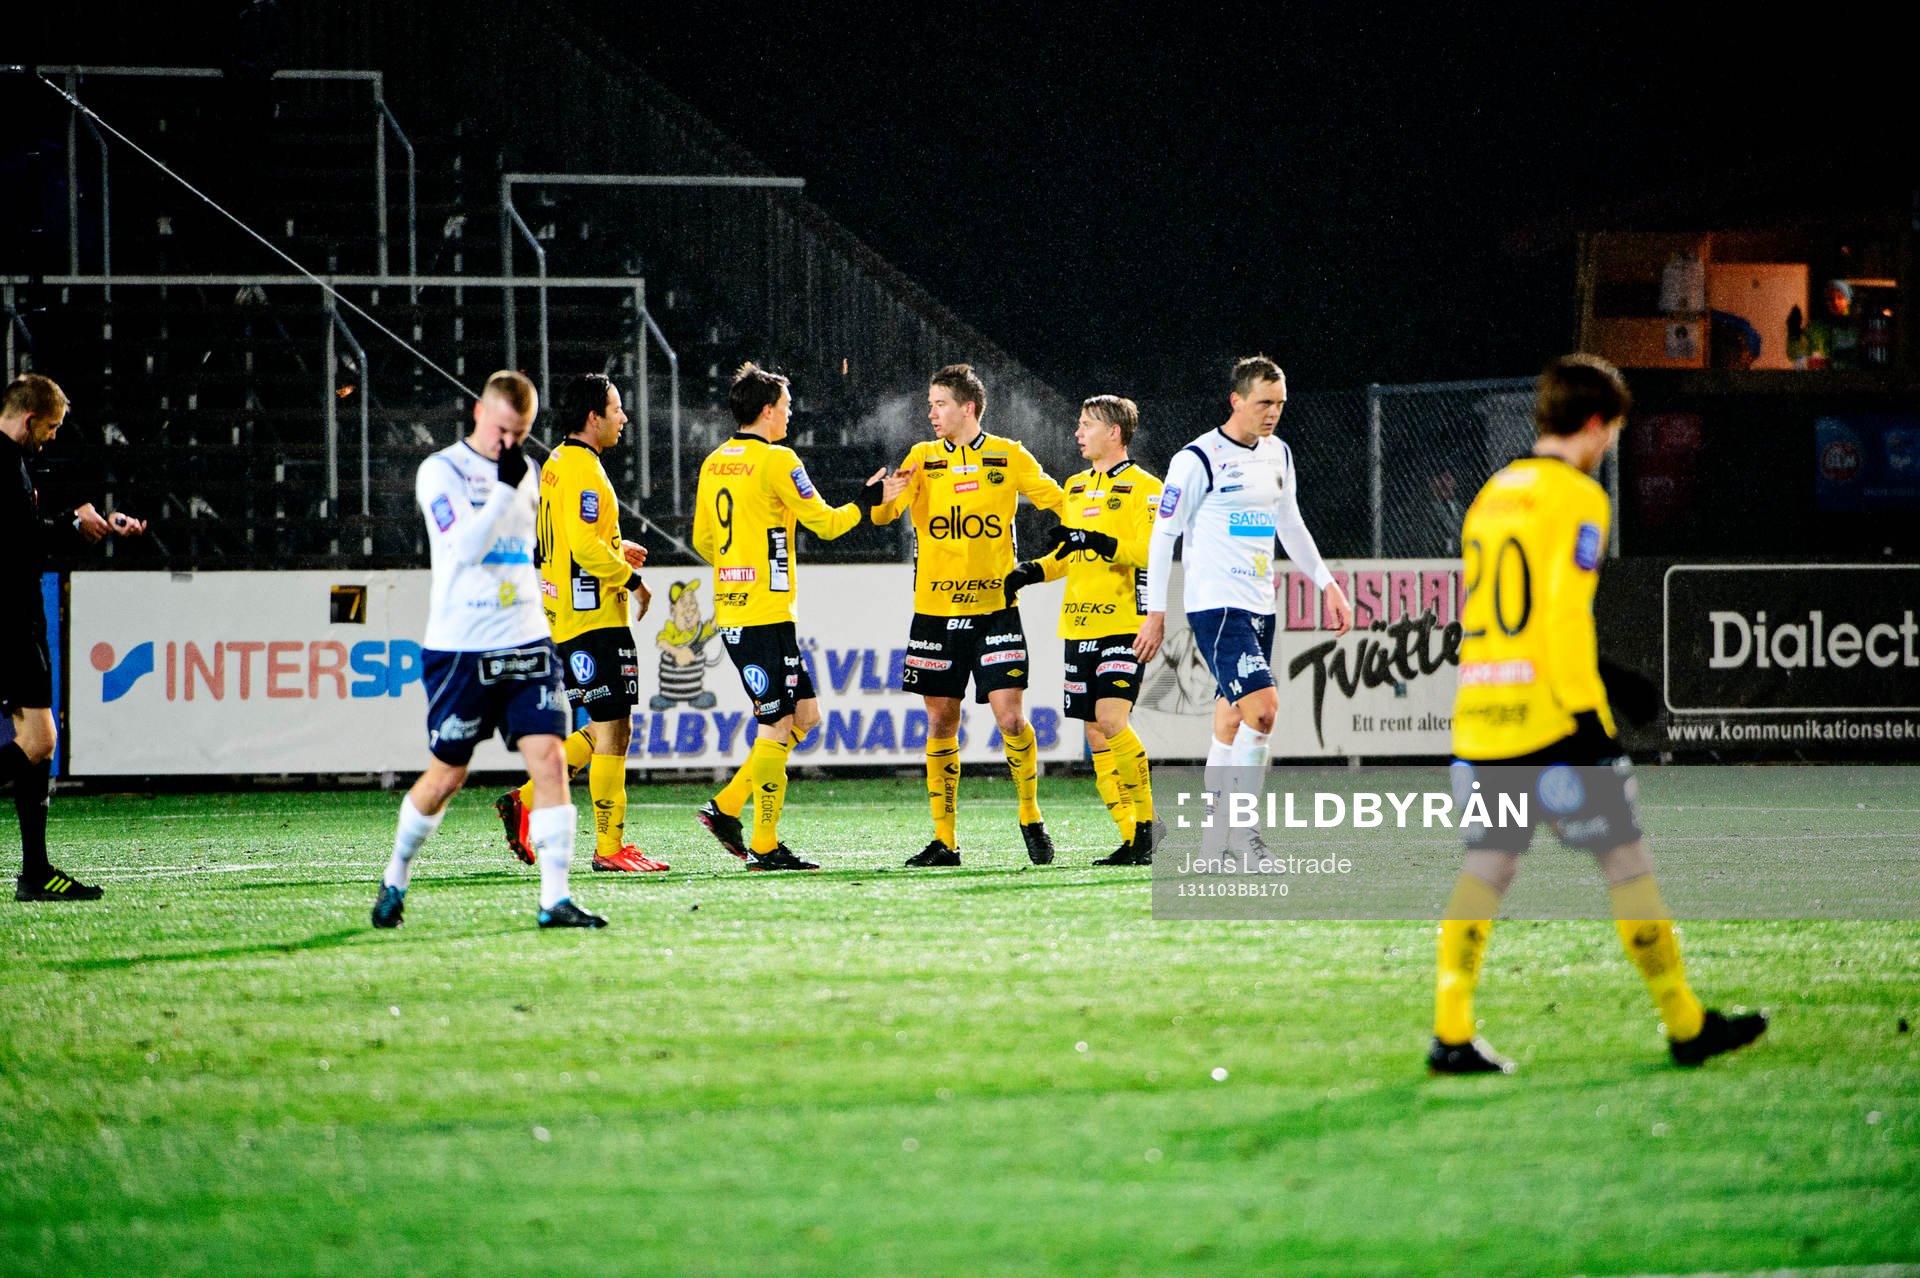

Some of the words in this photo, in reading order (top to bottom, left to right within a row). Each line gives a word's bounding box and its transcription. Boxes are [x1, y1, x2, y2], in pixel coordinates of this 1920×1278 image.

[716, 487, 734, 555] 9
[929, 505, 1003, 540] ellos
[930, 578, 1003, 592] TOVEKS
[951, 593, 979, 603] BIL
[1064, 602, 1117, 614] TOEKS
[946, 618, 975, 631] BIL
[1078, 641, 1100, 653] BIL
[1709, 610, 1919, 669] Dialect
[903, 668, 919, 684] 25
[1229, 679, 1243, 696] 14
[1352, 714, 1374, 732] Ett
[1380, 717, 1412, 732] rent
[1666, 720, 1920, 741] www.kommunikationstek
